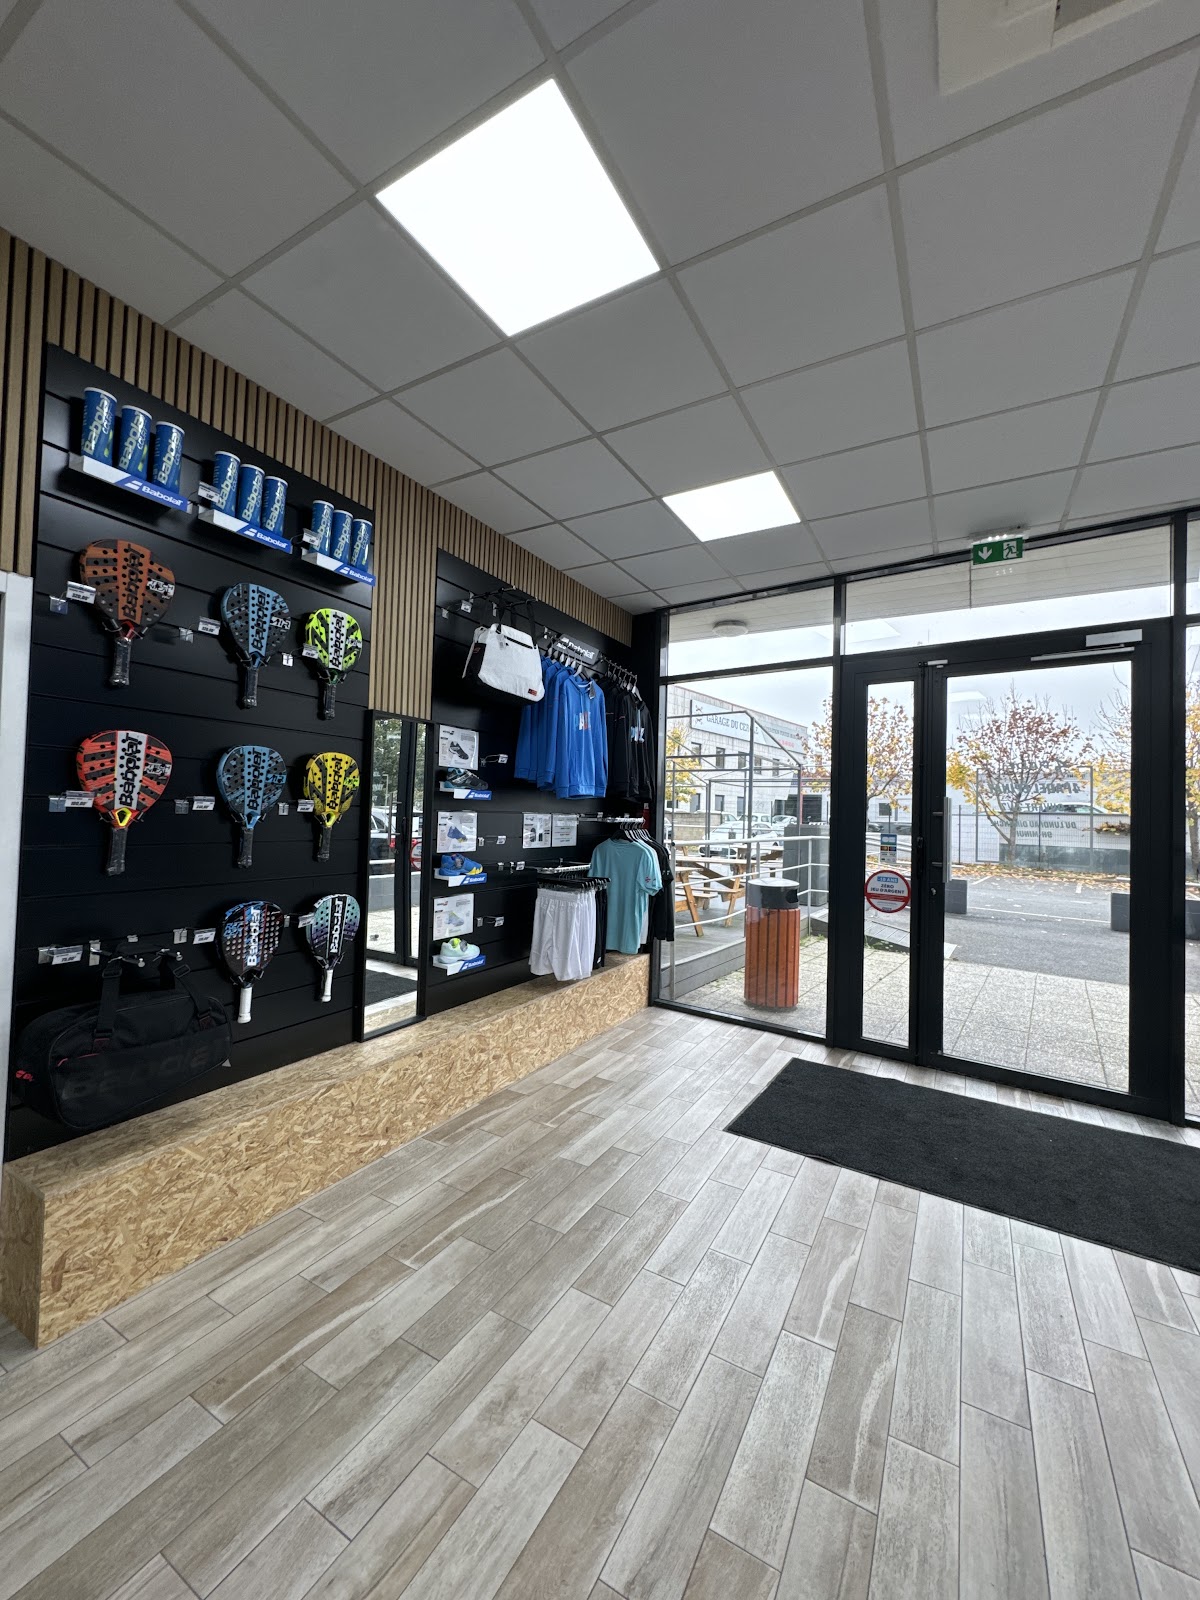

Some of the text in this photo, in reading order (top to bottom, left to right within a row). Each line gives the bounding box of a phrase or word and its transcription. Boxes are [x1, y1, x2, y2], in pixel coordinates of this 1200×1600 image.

[142, 485, 183, 506] Babolat
[256, 532, 288, 549] Babolat
[123, 543, 142, 621] Babolat
[349, 569, 373, 583] Babolat
[252, 586, 266, 651] Babolat
[331, 612, 344, 668] Babolat
[706, 714, 730, 729] GARAGE
[731, 720, 739, 730] DU
[120, 733, 138, 806] Babolat
[248, 747, 262, 811] Babolat
[327, 755, 342, 810] Babolat
[247, 906, 260, 966] Babolat
[330, 898, 343, 953] Babolat
